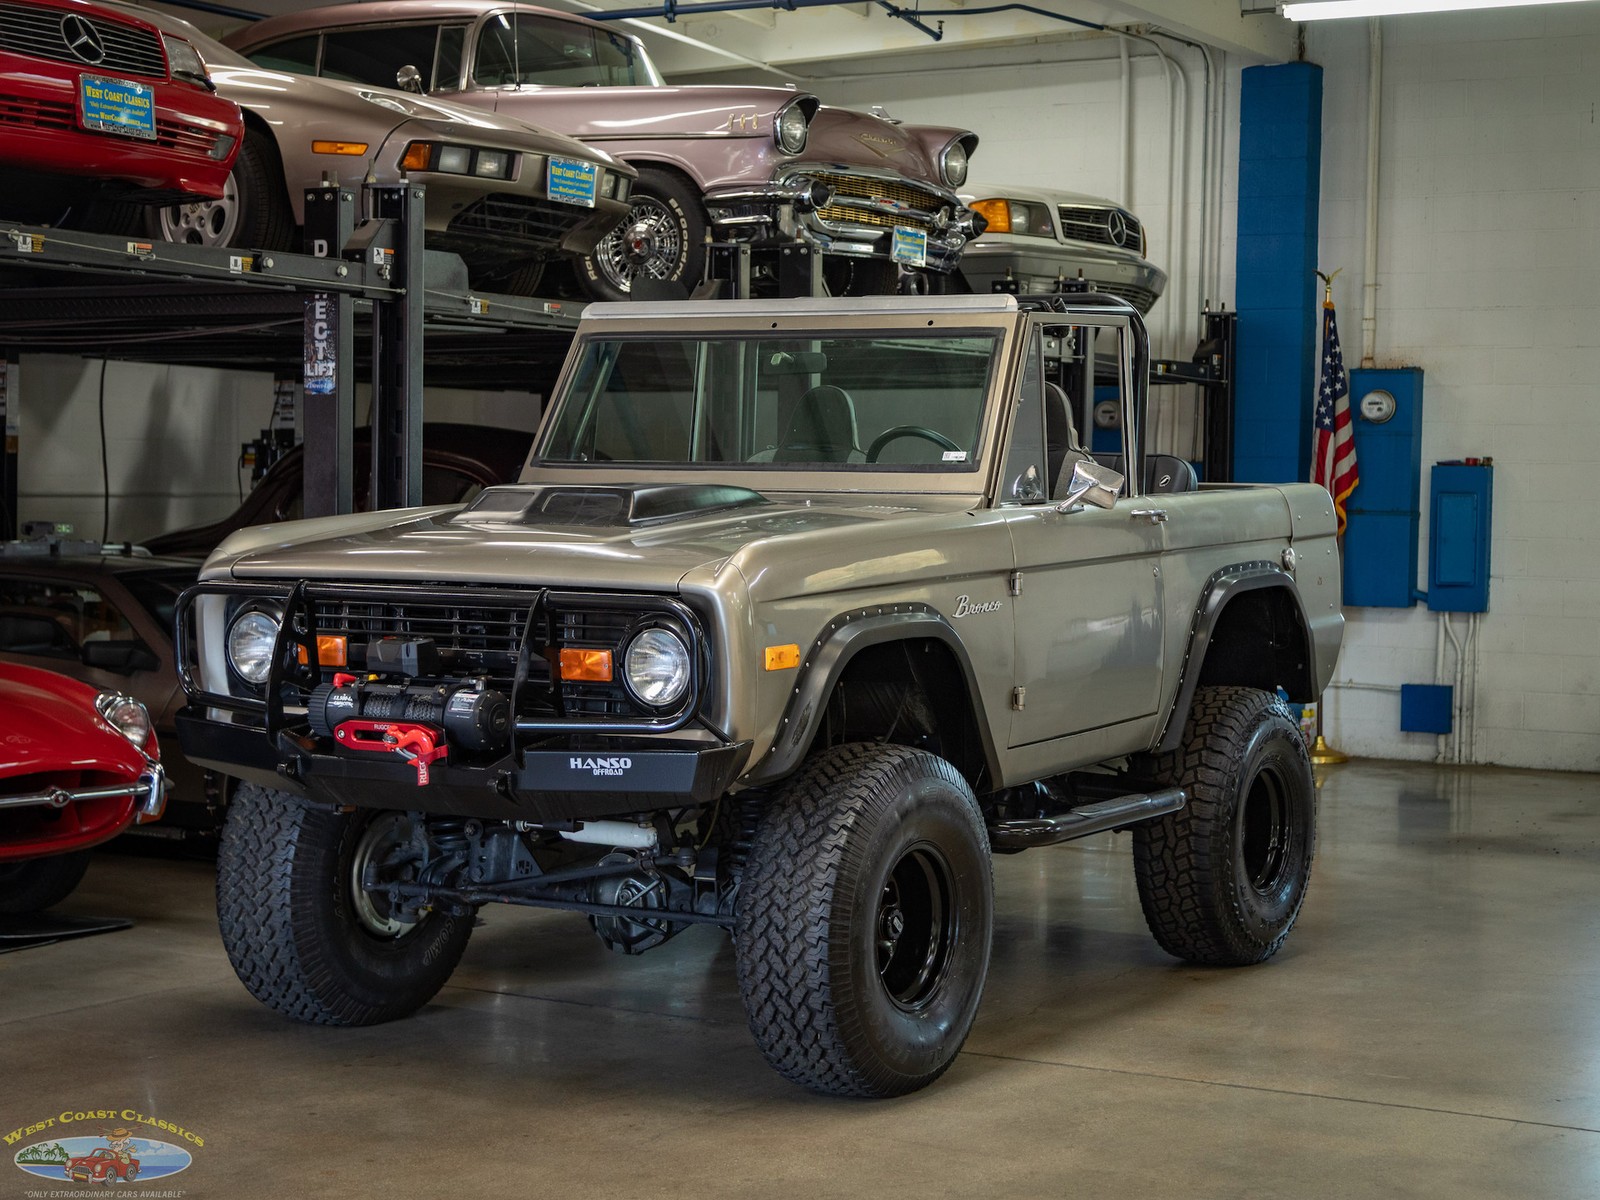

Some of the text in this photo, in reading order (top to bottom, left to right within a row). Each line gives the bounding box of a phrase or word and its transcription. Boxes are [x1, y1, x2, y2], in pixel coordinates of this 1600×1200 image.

[86, 85, 150, 109] WEST COAST CLASSICS
[305, 362, 336, 376] LIFT
[951, 594, 1003, 618] Bronco
[569, 757, 632, 769] HANSO
[592, 768, 624, 776] OFFROAD
